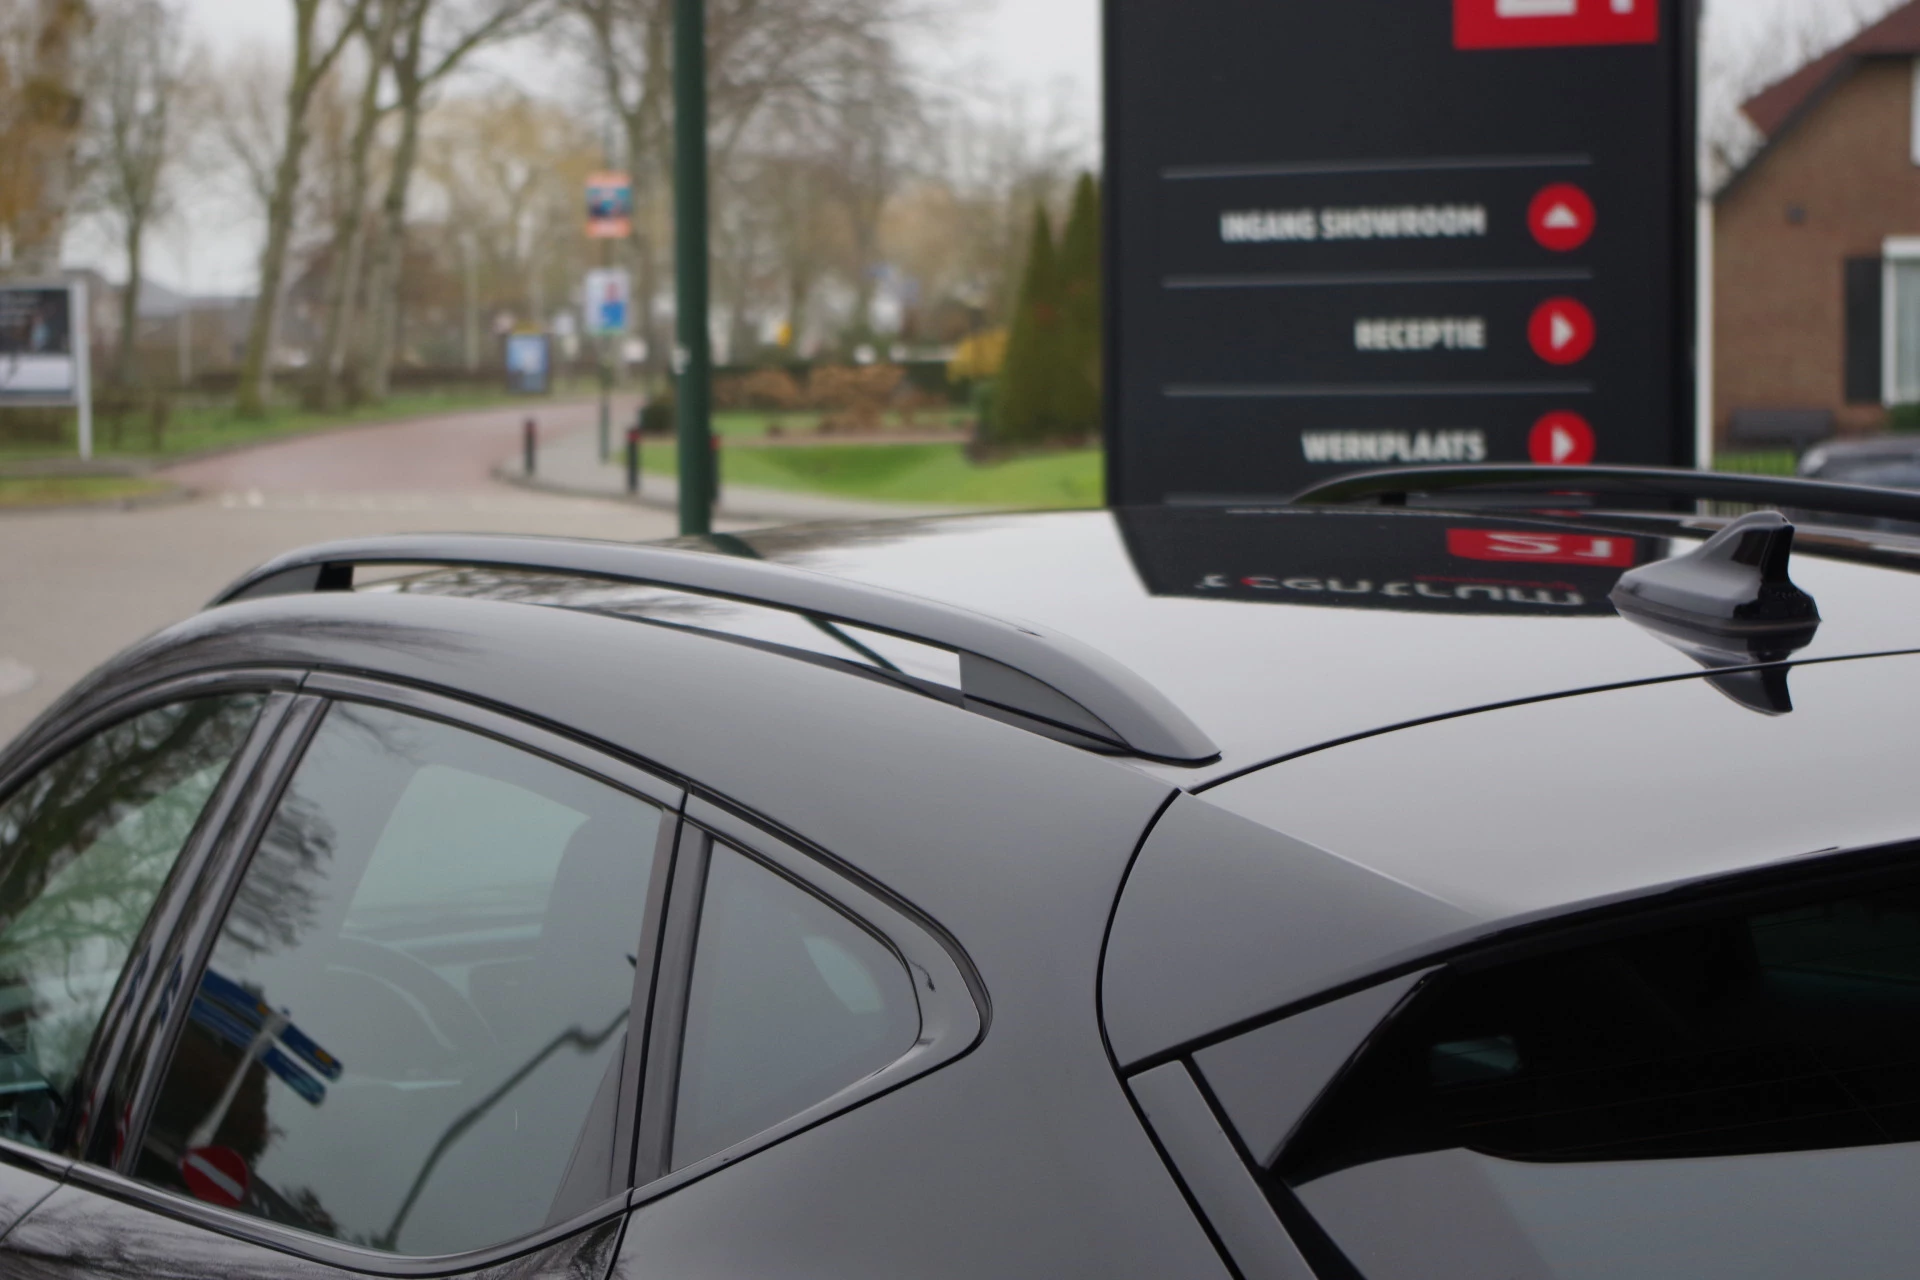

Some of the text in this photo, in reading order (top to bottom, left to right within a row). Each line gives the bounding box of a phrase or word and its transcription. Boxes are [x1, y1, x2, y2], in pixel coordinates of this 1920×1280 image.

[1221, 205, 1487, 243] INGANG SHOWROOM
[1354, 318, 1486, 351] RECEPTIE
[1301, 430, 1487, 462] WERKPLAATS
